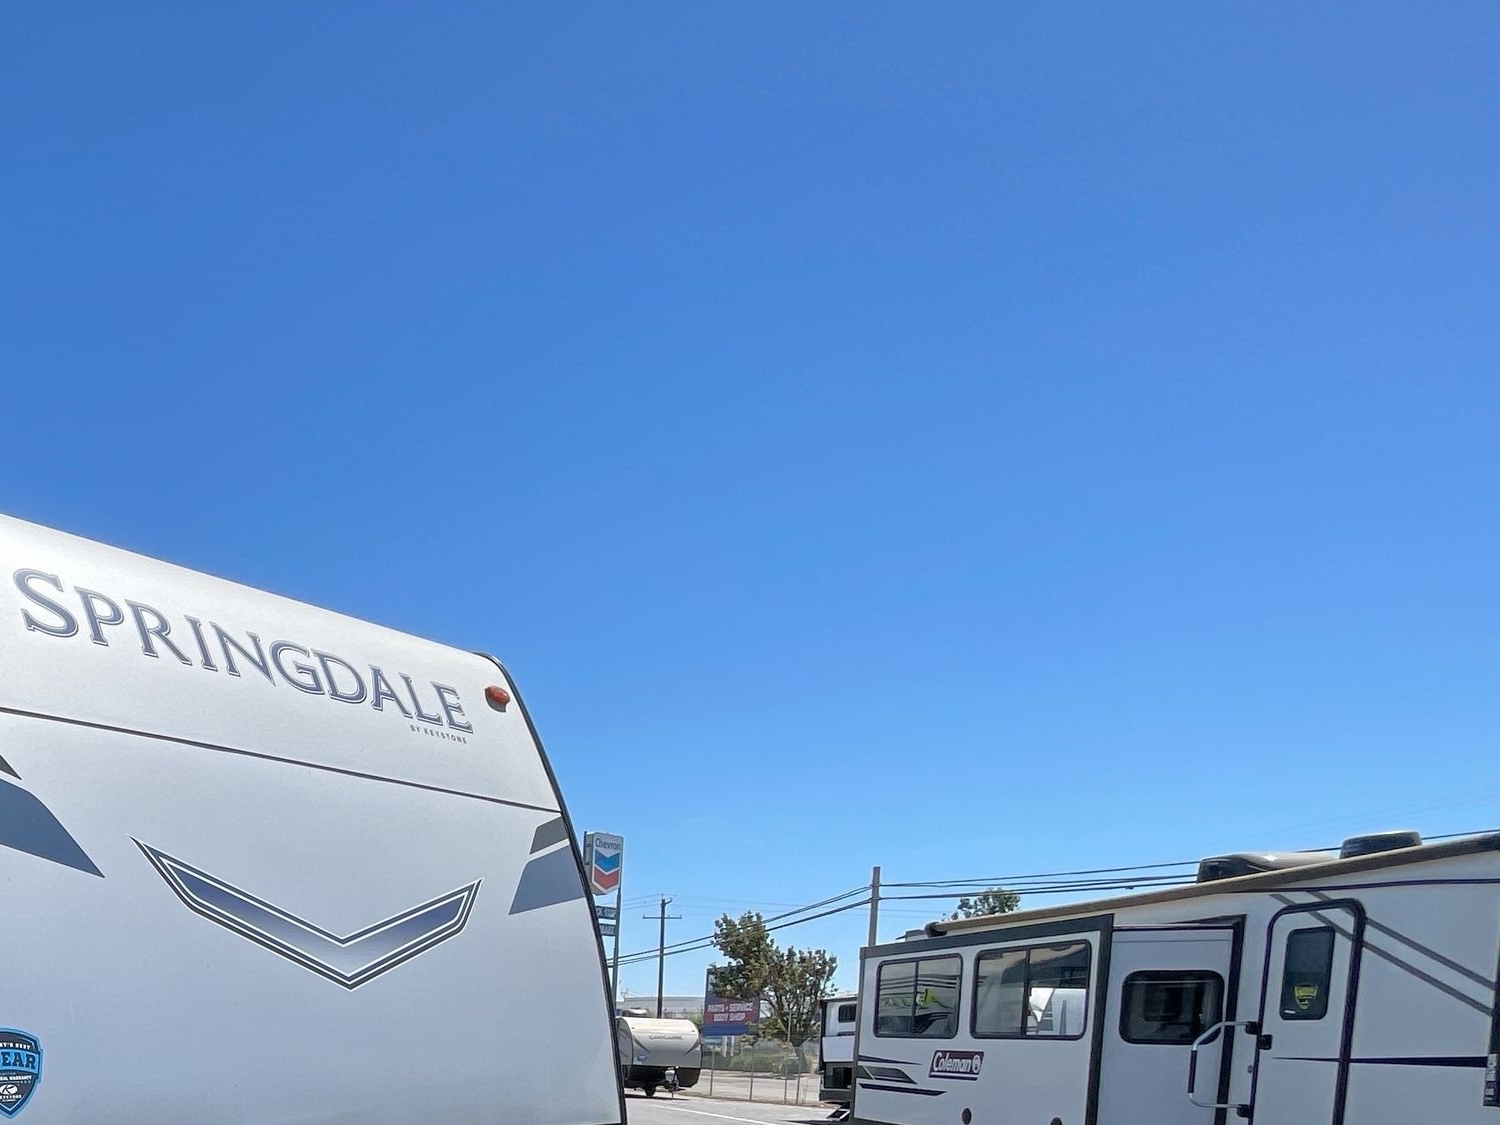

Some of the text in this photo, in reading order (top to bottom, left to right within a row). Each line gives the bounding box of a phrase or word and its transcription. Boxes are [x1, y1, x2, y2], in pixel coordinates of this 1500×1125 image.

[13, 567, 474, 734] SPRINGDALE
[410, 724, 467, 744] BY KEYSTONE
[595, 837, 621, 851] Chevron
[707, 1002, 754, 1013] PARTS SERVICE
[933, 1051, 972, 1073] Coleman
